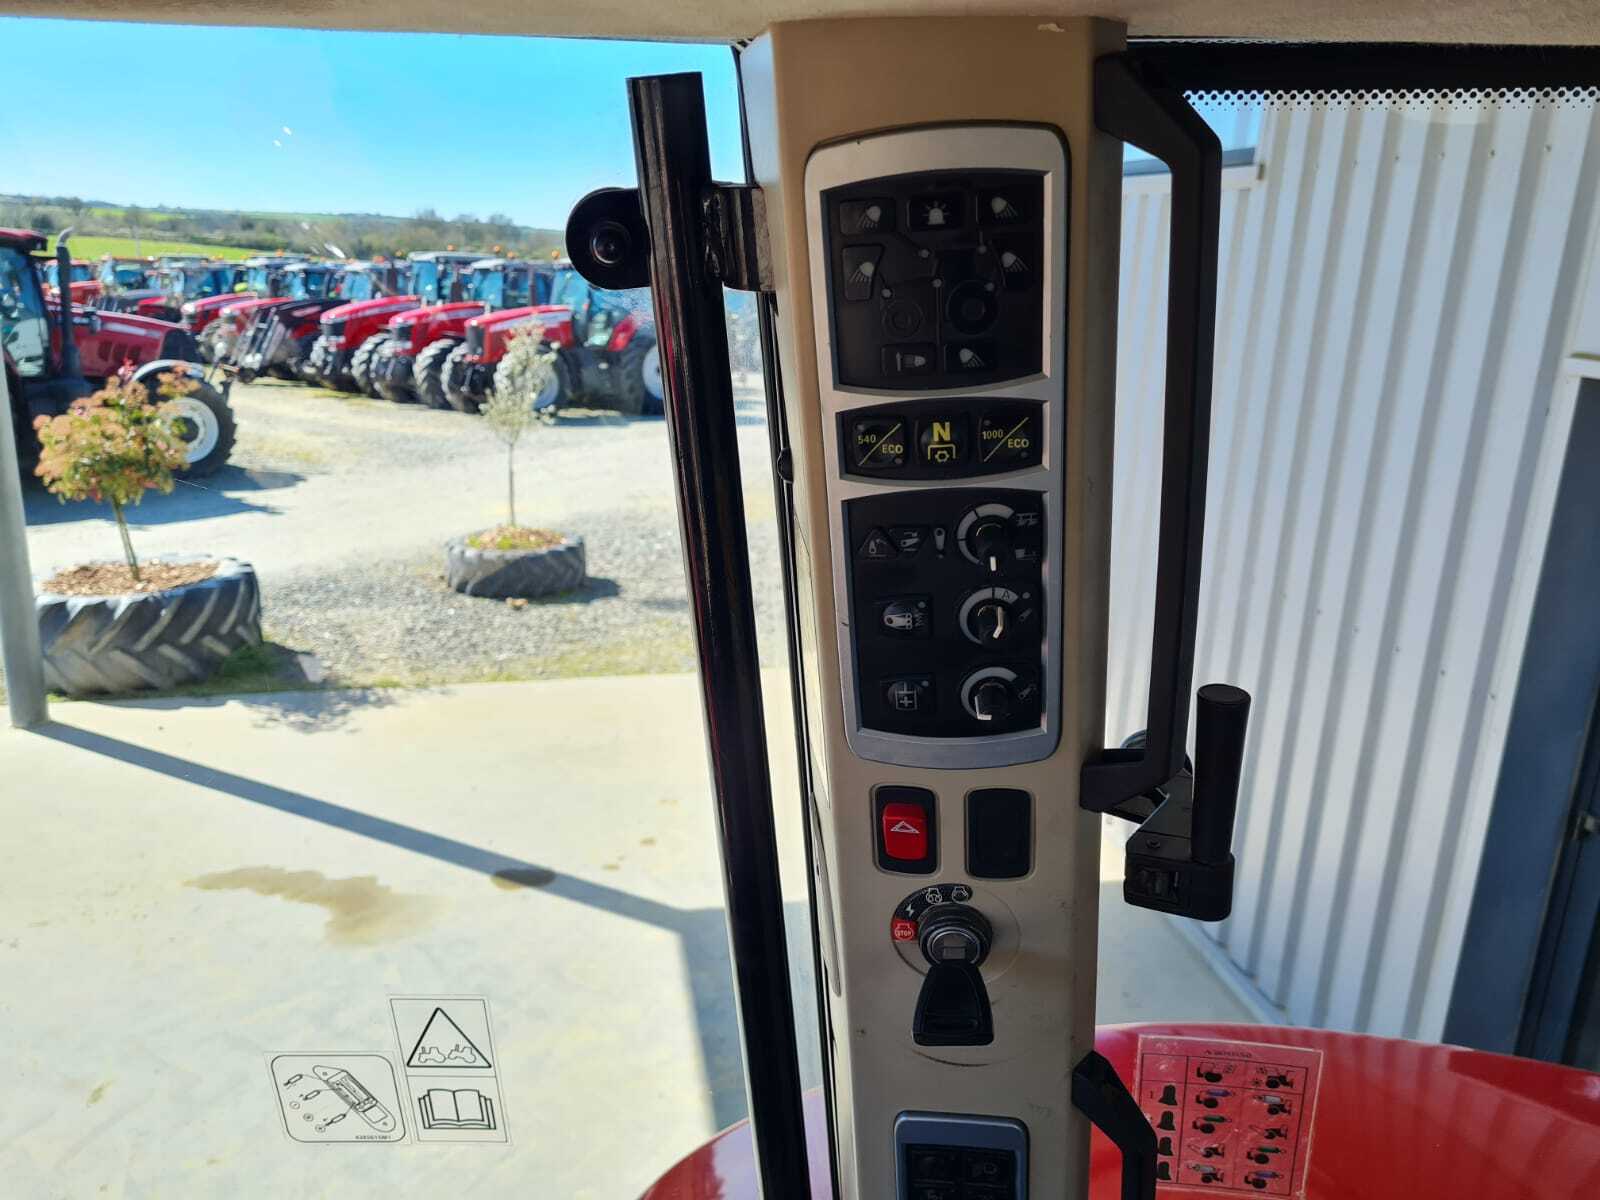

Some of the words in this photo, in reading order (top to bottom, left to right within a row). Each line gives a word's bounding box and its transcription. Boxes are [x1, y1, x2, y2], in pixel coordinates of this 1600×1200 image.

[932, 421, 951, 442] N
[982, 429, 1004, 440] 1000
[857, 434, 877, 445] 540
[1007, 438, 1030, 449] ECO
[881, 444, 904, 455] ECO
[895, 929, 912, 937] STOP
